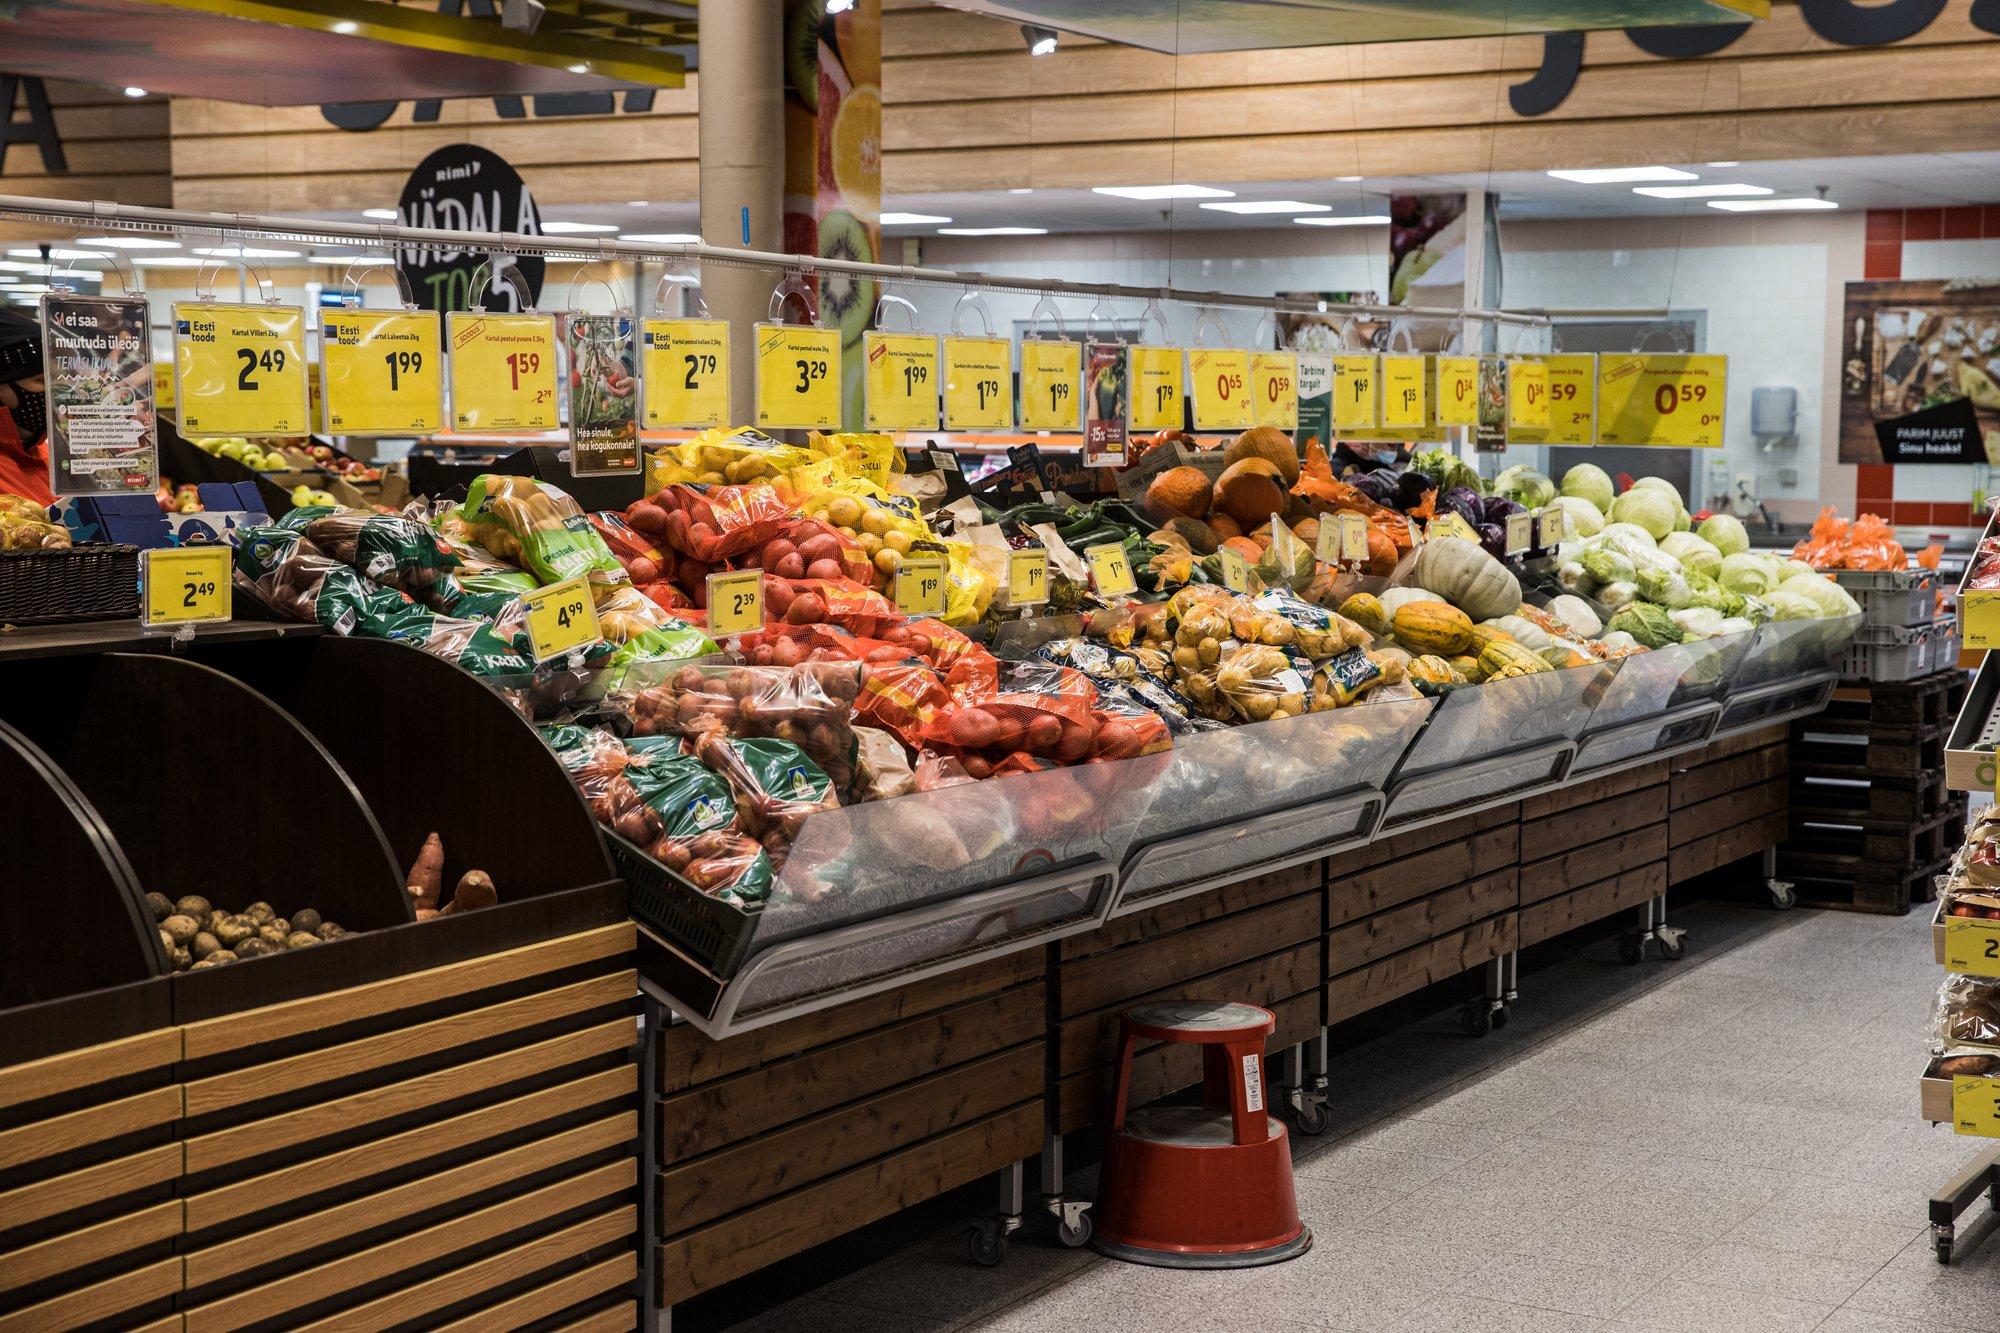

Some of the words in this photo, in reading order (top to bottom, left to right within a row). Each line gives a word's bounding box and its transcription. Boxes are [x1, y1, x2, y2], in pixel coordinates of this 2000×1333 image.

[66, 312, 76, 326] ei
[78, 315, 98, 327] saa
[193, 321, 215, 331] Eesti
[231, 328, 249, 337] Kartul
[267, 330, 279, 338] 2kg
[340, 326, 360, 335] Eesti
[55, 335, 106, 349] muutuda
[108, 335, 139, 350] üleöö
[191, 333, 216, 342] toode
[655, 333, 671, 341] Eesti
[1301, 364, 1326, 376] Tarbime
[1551, 384, 1577, 401] 59
[577, 428, 590, 438] Hea
[592, 427, 613, 438] sinule,
[1896, 428, 1931, 439] PARIM
[577, 441, 590, 451] hea
[590, 439, 635, 453] kogukonnale!
[1899, 442, 1924, 454] Sinu
[543, 545, 575, 564] Pestud
